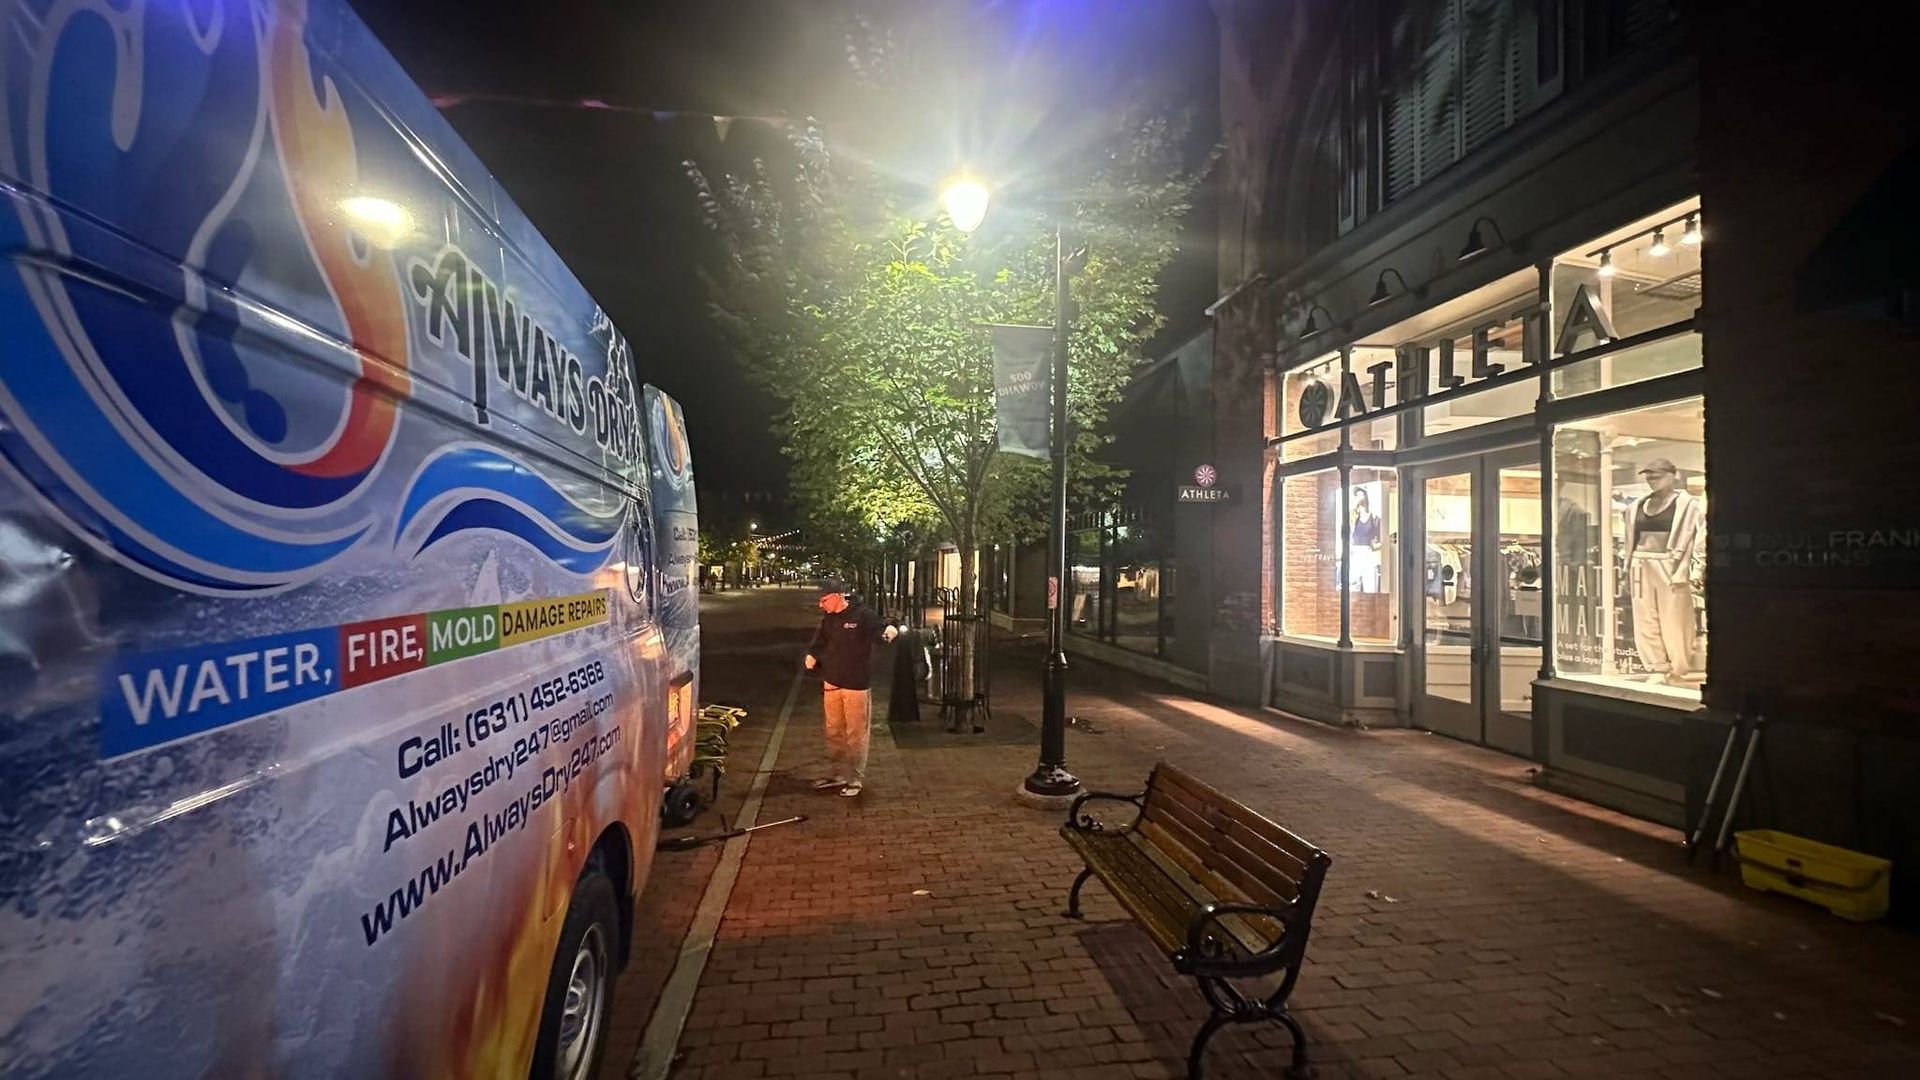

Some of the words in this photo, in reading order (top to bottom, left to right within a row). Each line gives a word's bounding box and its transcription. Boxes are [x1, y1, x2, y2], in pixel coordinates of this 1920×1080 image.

[1334, 283, 1621, 420] ATHLETA
[588, 377, 634, 464] DRY
[1181, 489, 1230, 499] ATHLETA
[1557, 565, 1643, 599] MATCH
[1755, 550, 1870, 567] COLLINS
[117, 642, 333, 726] WATER,
[346, 625, 425, 669] FIRE,
[431, 614, 496, 653] MOLD
[502, 603, 565, 637] DAMAGE
[568, 597, 606, 626] REPAIRS
[1565, 642, 1578, 650] set
[398, 722, 461, 779] Call:
[465, 693, 528, 747] (631)
[531, 661, 604, 711] 452-6368
[383, 692, 614, 853] Alwaysdry247@gmail.com
[360, 725, 620, 946] www.AlwaysDry247.com
